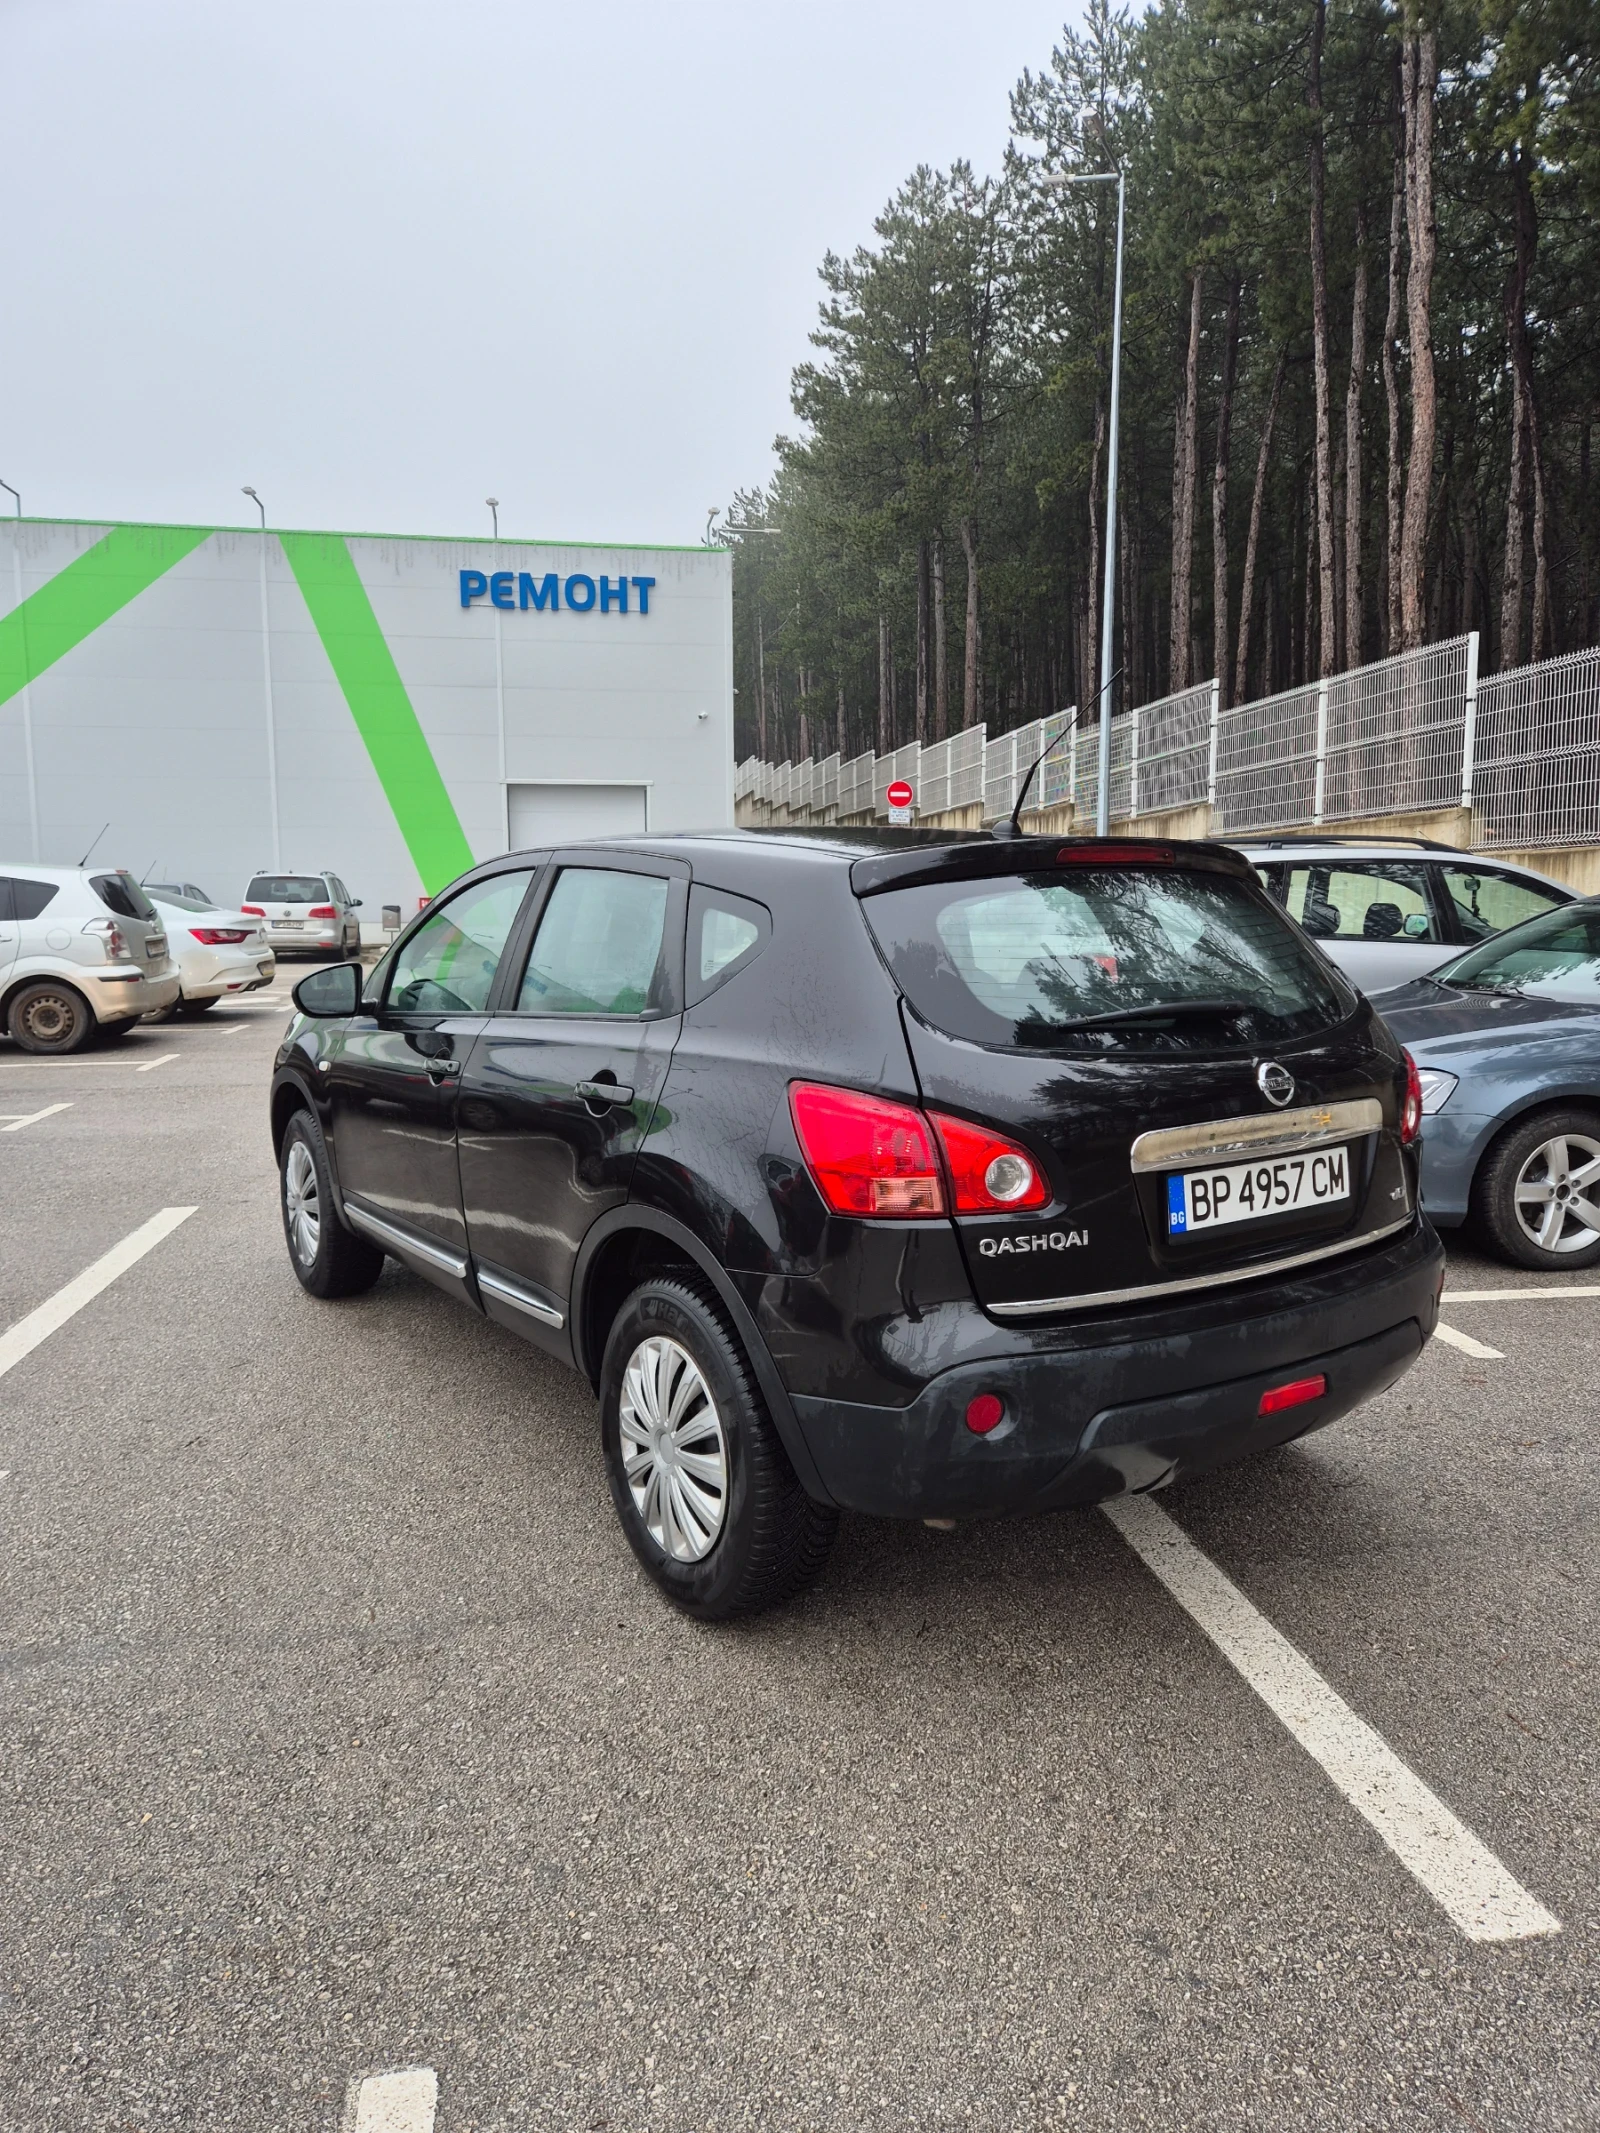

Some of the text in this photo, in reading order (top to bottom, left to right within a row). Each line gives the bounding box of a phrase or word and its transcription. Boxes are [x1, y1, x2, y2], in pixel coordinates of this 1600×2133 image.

[460, 570, 655, 613] РЕМОНТ
[1239, 1161, 1305, 1212] 4957
[1170, 1211, 1186, 1226] BG
[979, 1229, 1088, 1257] QASHQAI
